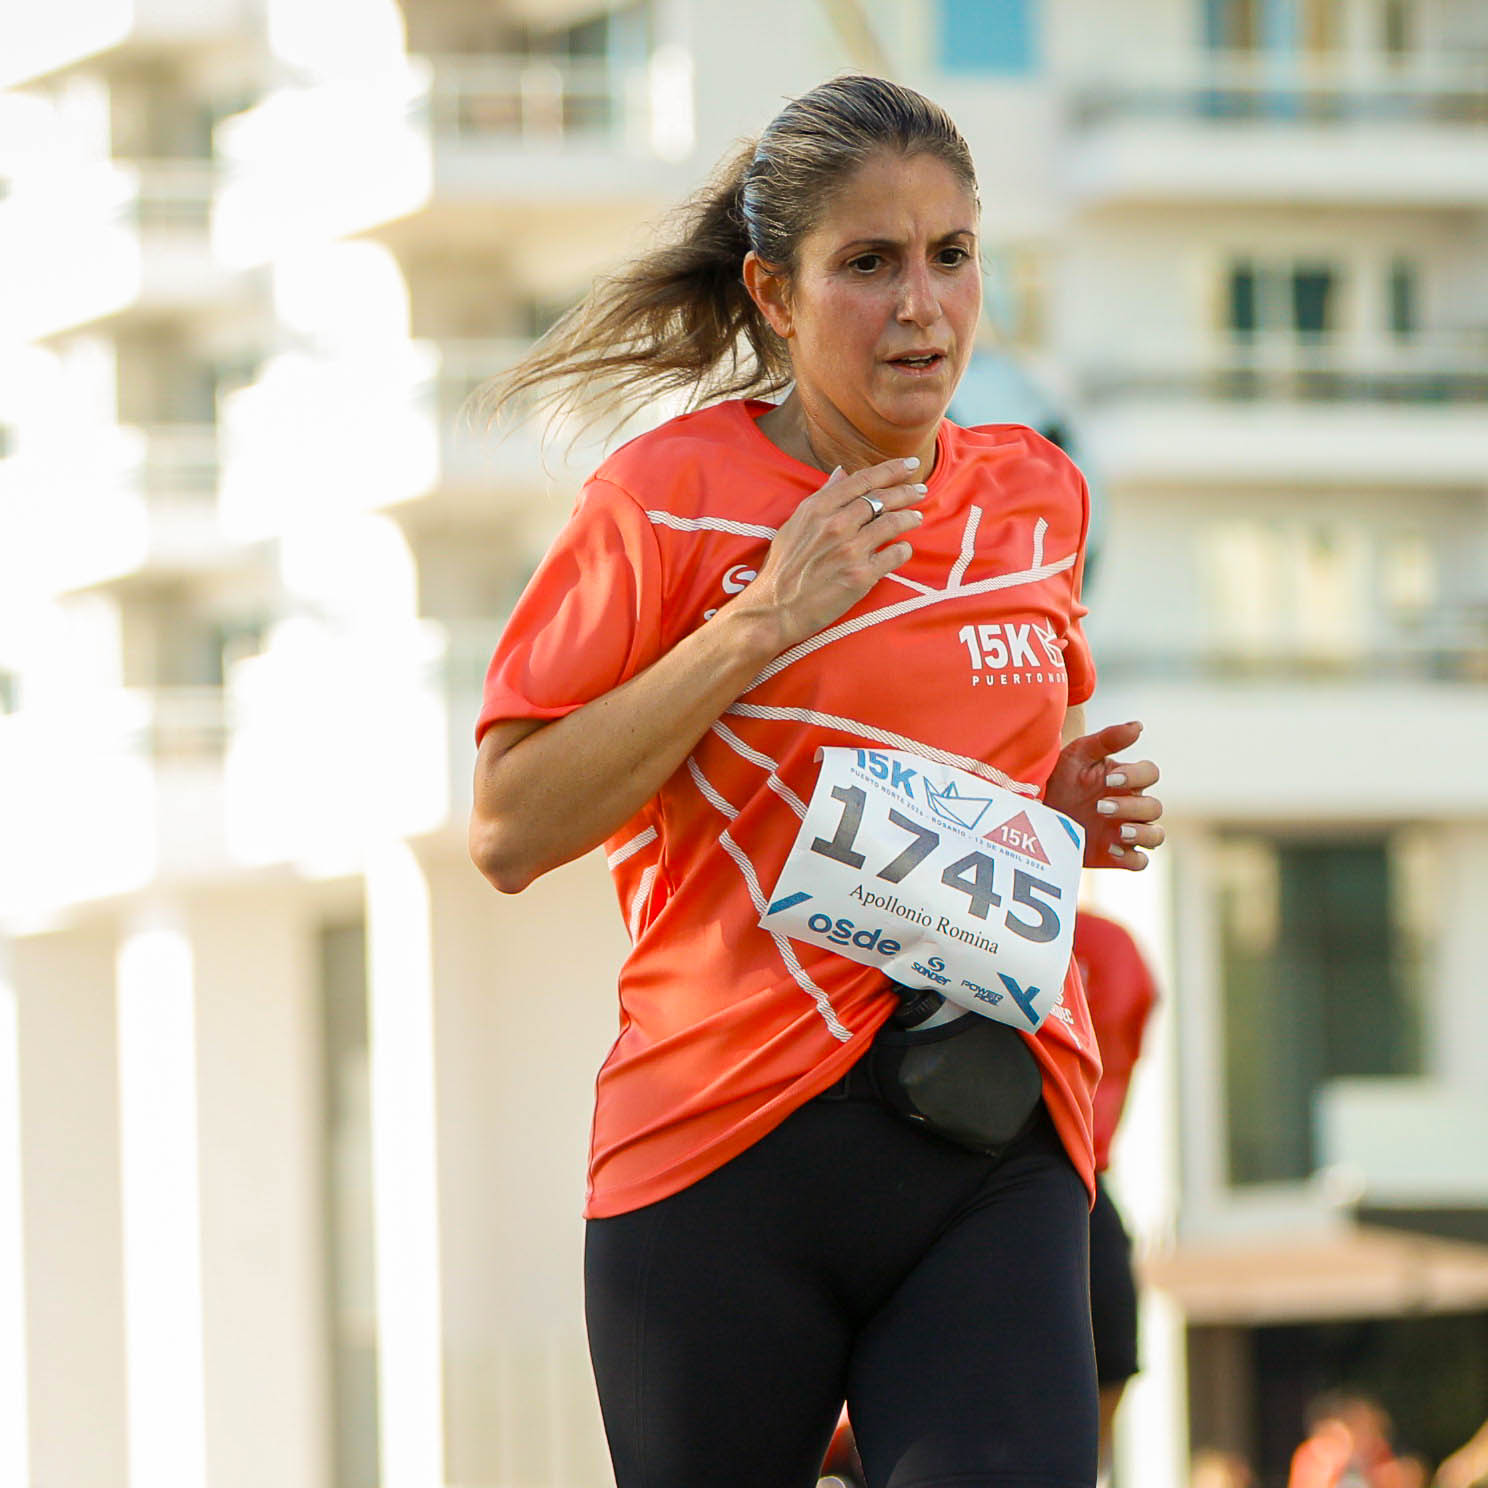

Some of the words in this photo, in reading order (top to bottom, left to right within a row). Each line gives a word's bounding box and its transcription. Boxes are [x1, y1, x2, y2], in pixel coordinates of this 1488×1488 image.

[959, 623, 1041, 669] 15K
[972, 673, 1043, 686] PUERTO
[850, 748, 917, 799] 15K
[1000, 825, 1037, 854] 15K
[810, 785, 1062, 943] 1745
[807, 913, 902, 956] osde
[849, 884, 932, 928] Apollonio
[936, 915, 1000, 954] Romina
[960, 979, 1004, 1001] POWER
